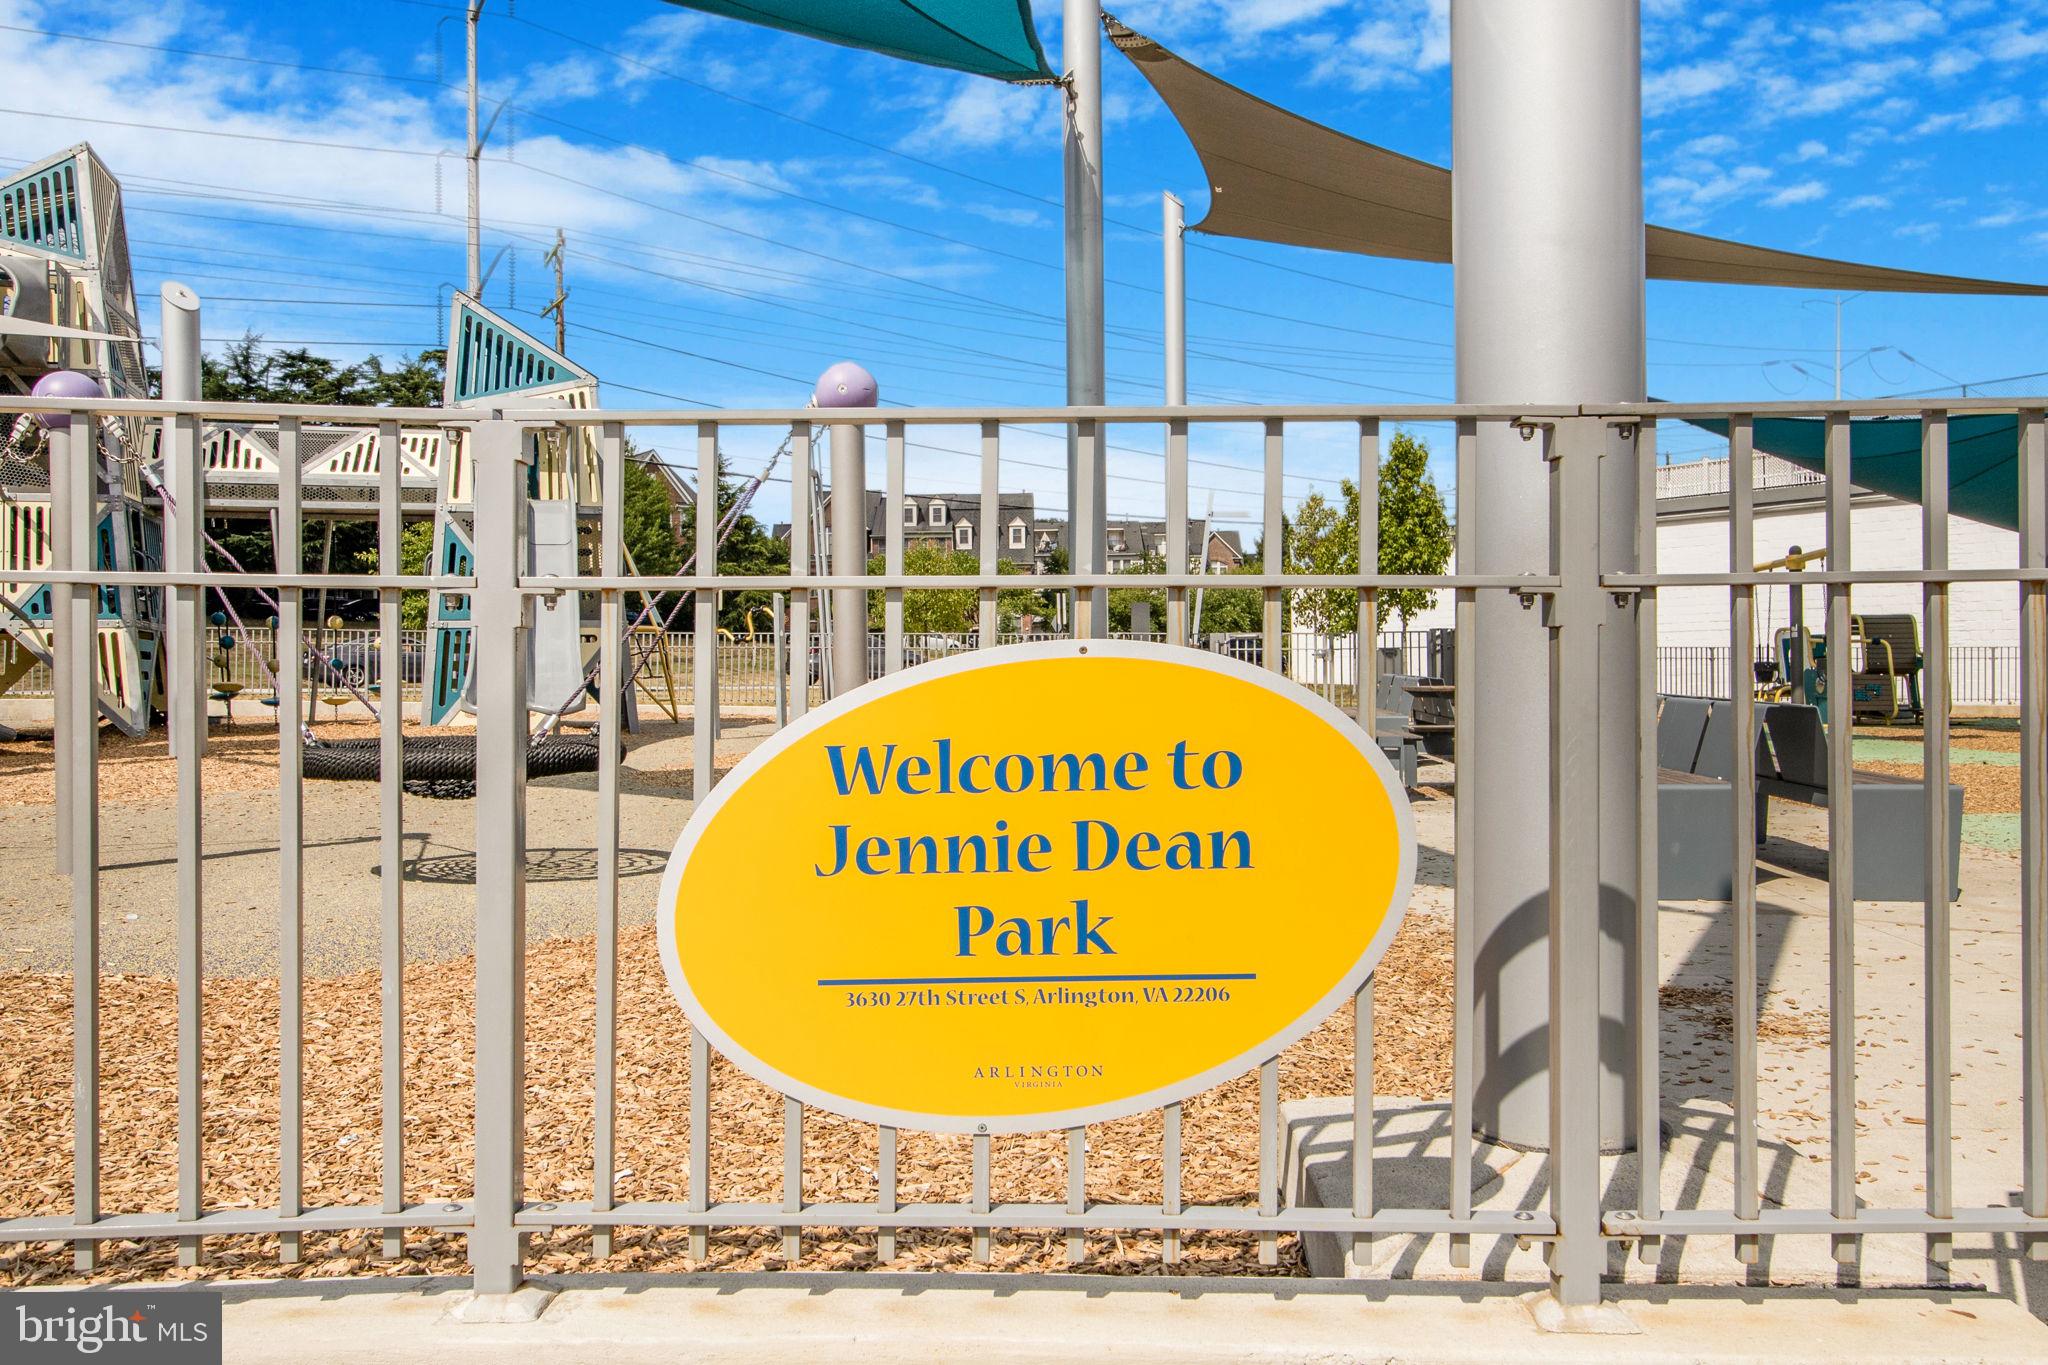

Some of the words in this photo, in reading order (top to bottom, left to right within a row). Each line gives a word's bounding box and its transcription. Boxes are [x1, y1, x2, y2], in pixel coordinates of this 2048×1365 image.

[823, 738, 1149, 796] Welcome
[1166, 739, 1243, 790] to
[814, 819, 1053, 878] Jennie
[1071, 819, 1255, 872] Dean
[953, 899, 1118, 957] Park
[845, 991, 891, 1007] 3630
[896, 989, 940, 1006] 27th
[946, 989, 1009, 1006] Street
[1014, 988, 1029, 1006] S,
[1033, 986, 1139, 1008] Arlington,
[1142, 986, 1169, 1003] VA
[1172, 986, 1231, 1003] 22206
[974, 1065, 1103, 1079] ARLINGTON
[1014, 1080, 1063, 1088] VIRGINIA
